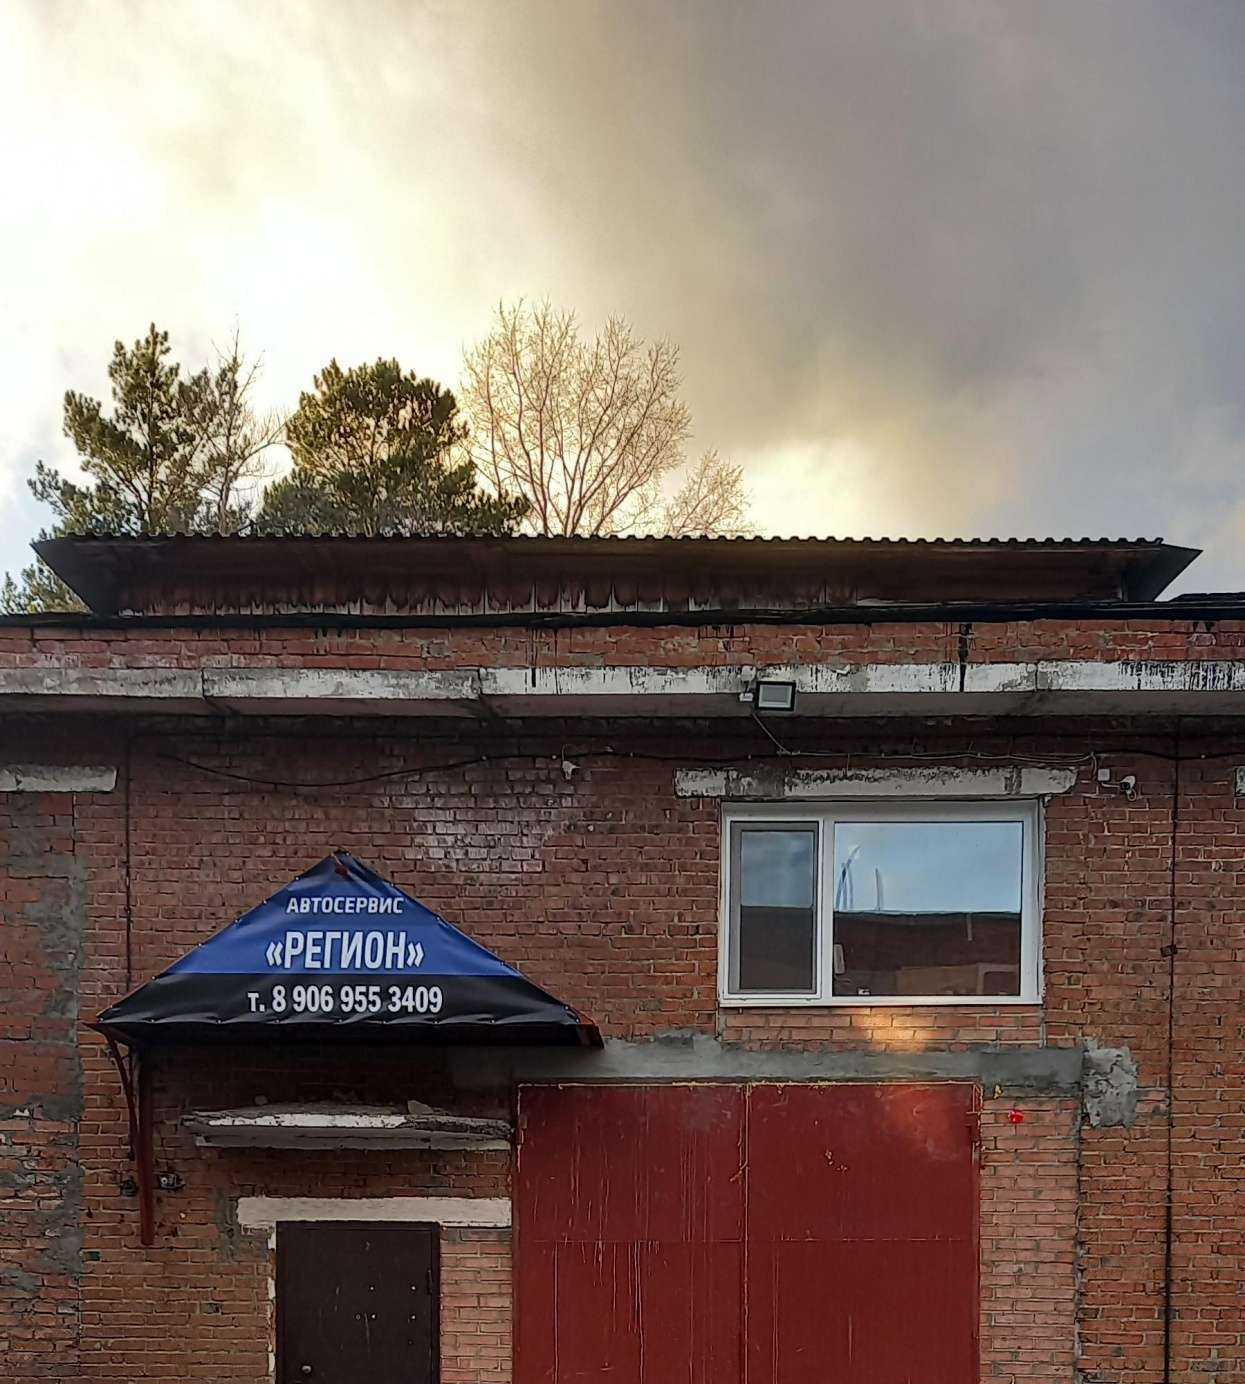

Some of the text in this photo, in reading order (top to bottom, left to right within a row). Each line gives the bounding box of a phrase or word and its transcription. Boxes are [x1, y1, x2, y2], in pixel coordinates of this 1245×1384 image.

[286, 897, 404, 914] АВТОСЕРВИС
[265, 931, 425, 969] «РЕГИОН»
[272, 985, 287, 1012] 8
[292, 985, 334, 1012] 906
[340, 985, 382, 1013] 955
[387, 985, 443, 1013] 3409
